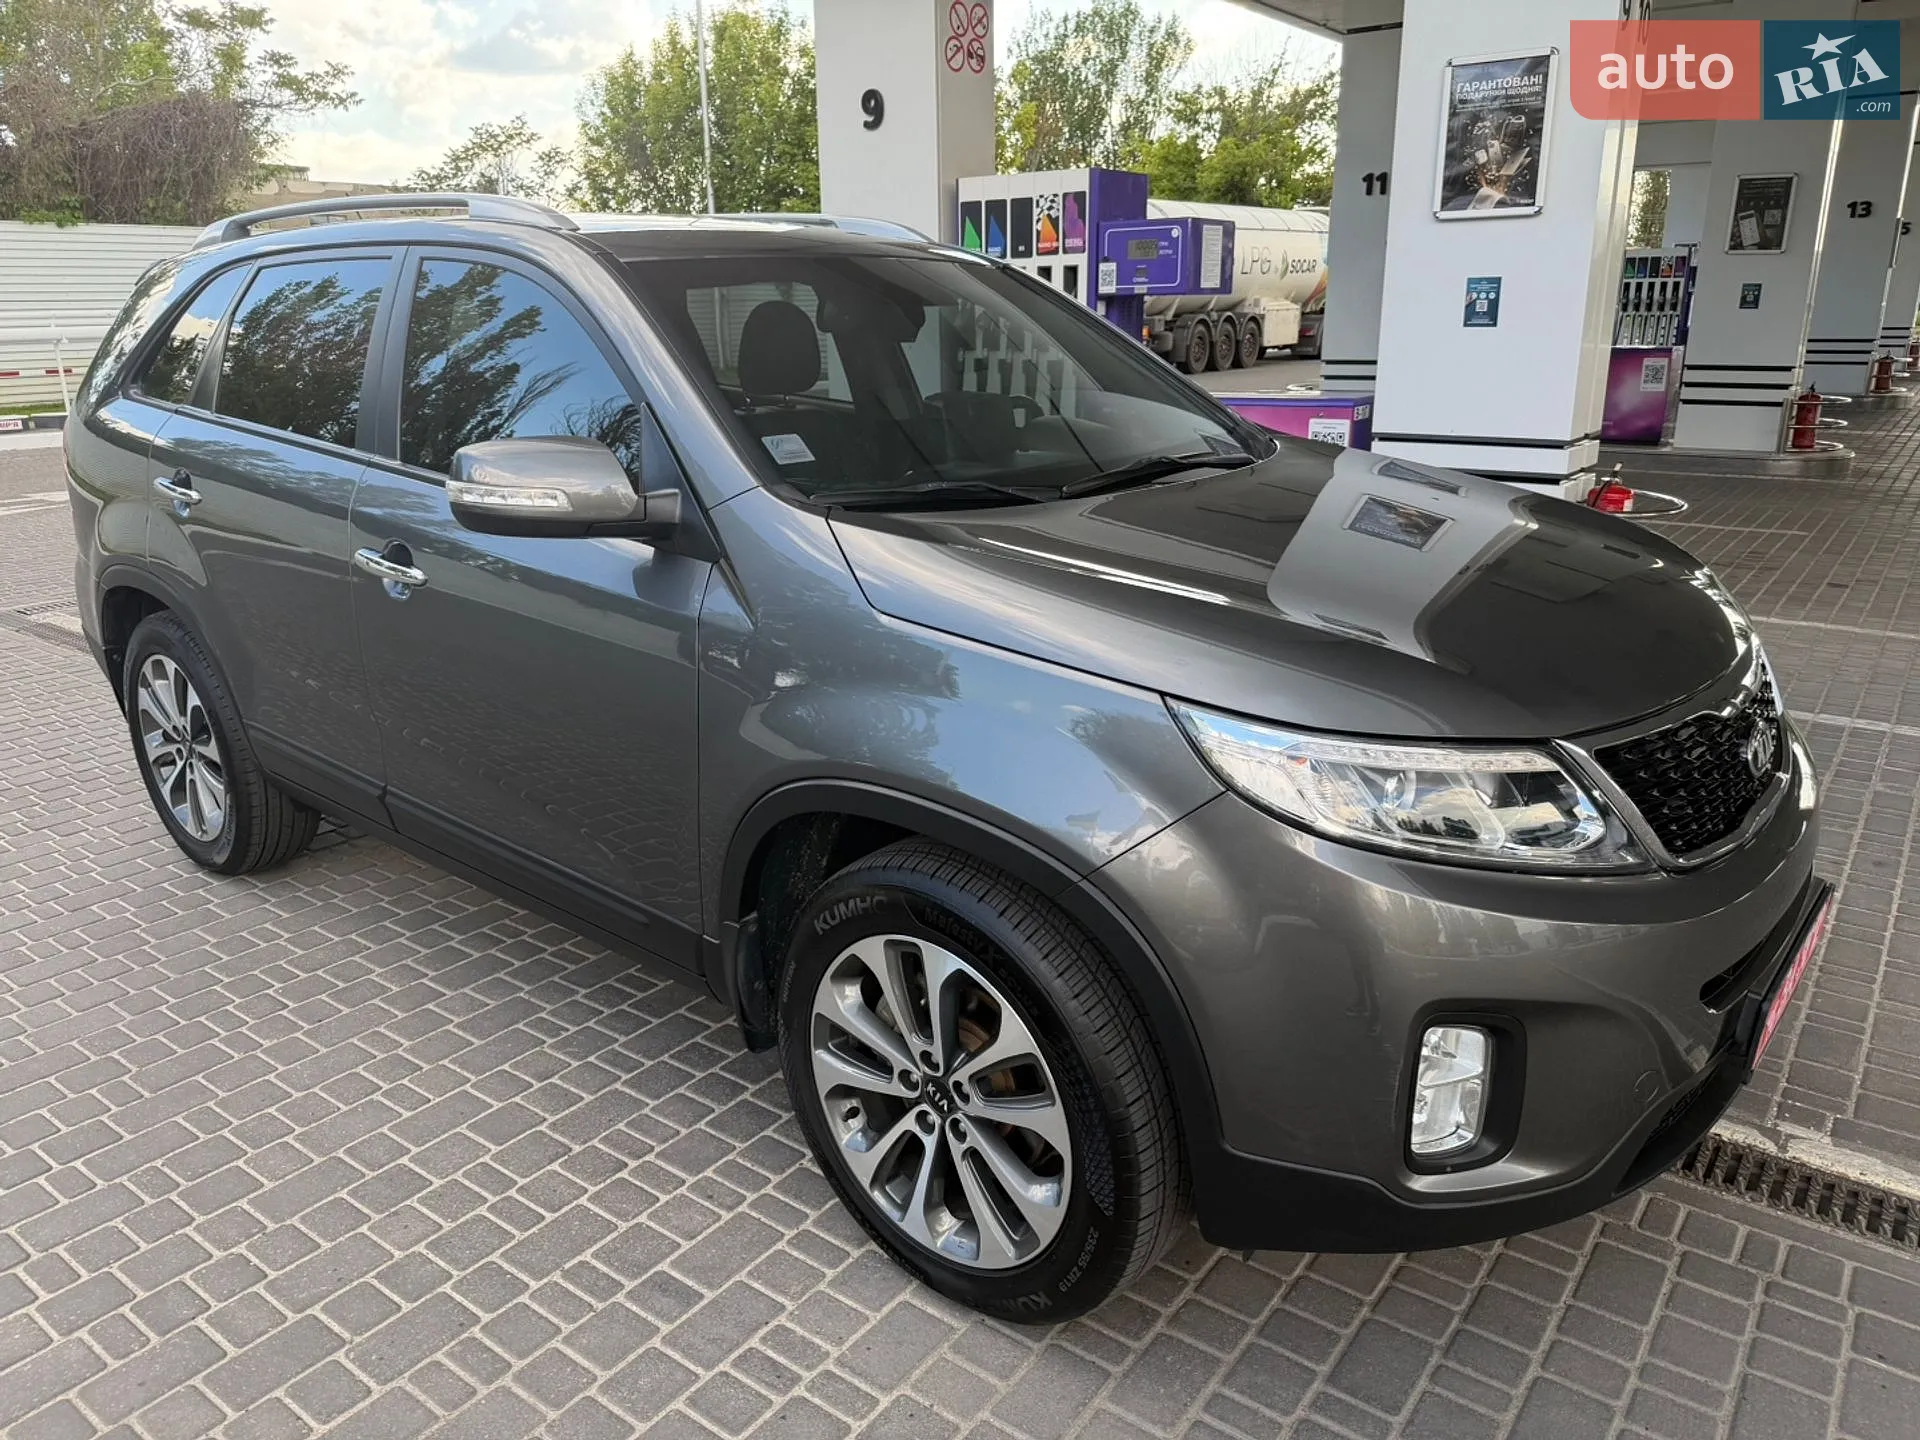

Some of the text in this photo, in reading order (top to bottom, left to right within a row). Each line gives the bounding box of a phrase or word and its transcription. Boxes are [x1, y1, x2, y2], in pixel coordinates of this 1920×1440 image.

[1457, 74, 1543, 93] ГАРАНТОВАНІ
[861, 89, 885, 130] 9
[1362, 172, 1388, 196] 11
[1847, 201, 1873, 218] 13
[1240, 246, 1272, 275] LPG
[1290, 259, 1317, 274] SOCAR
[926, 1081, 948, 1113] KIA
